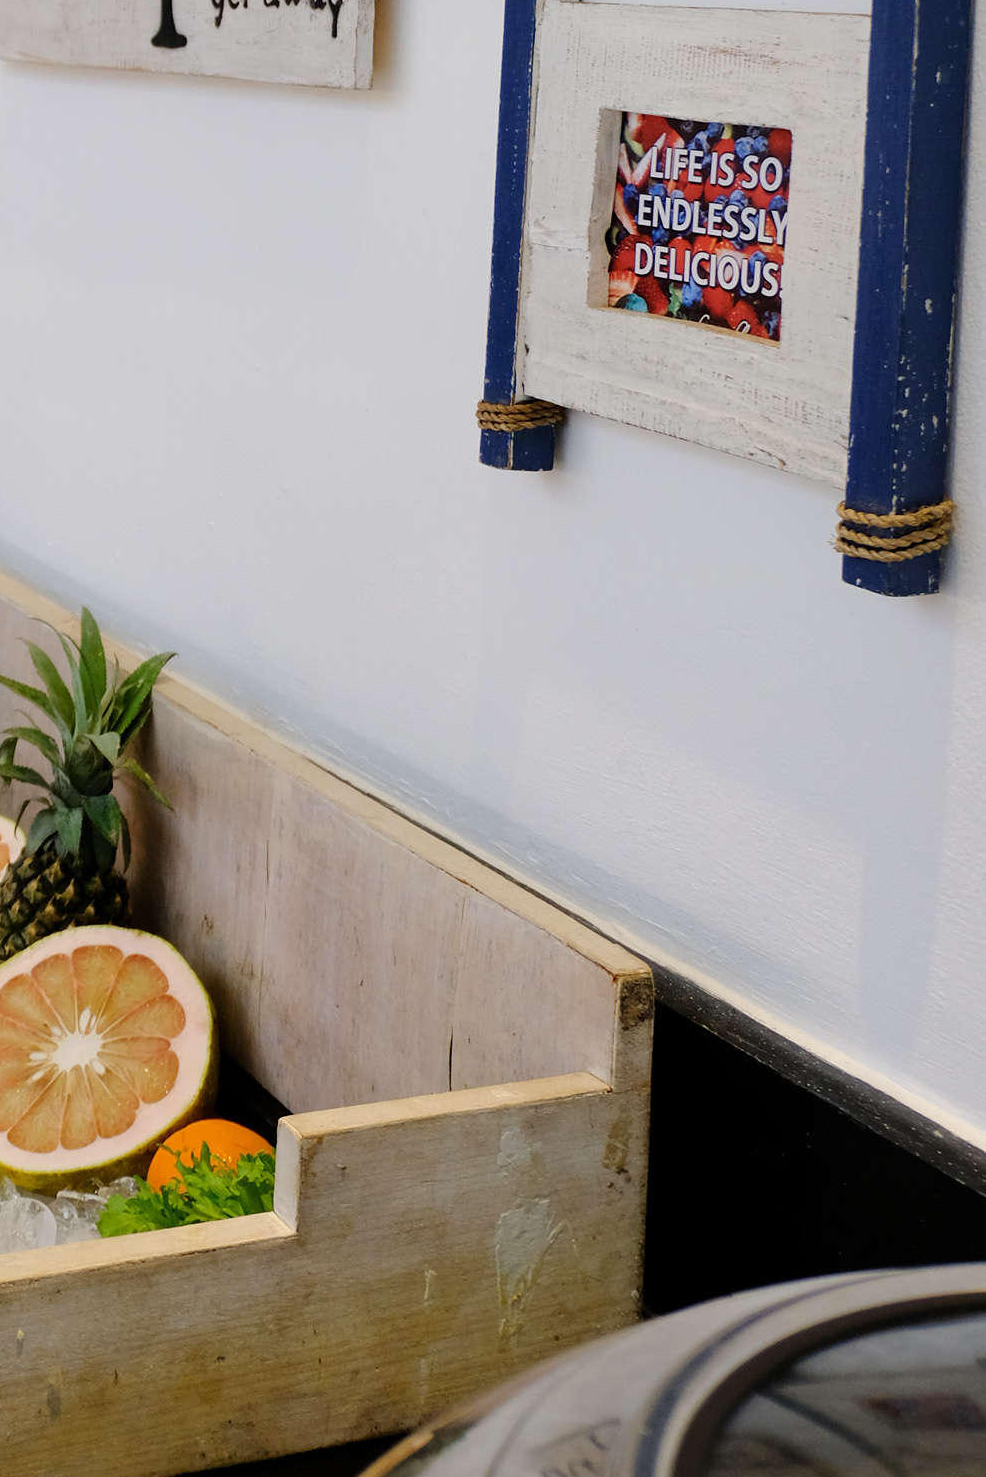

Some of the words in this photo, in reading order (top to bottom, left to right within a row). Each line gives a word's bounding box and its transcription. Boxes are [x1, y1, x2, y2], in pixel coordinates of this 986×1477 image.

[650, 146, 704, 184] LIFE
[709, 151, 735, 187] IS
[741, 154, 783, 192] SO
[637, 193, 787, 246] ENDLESSLY
[634, 241, 782, 298] DELICIOUS
